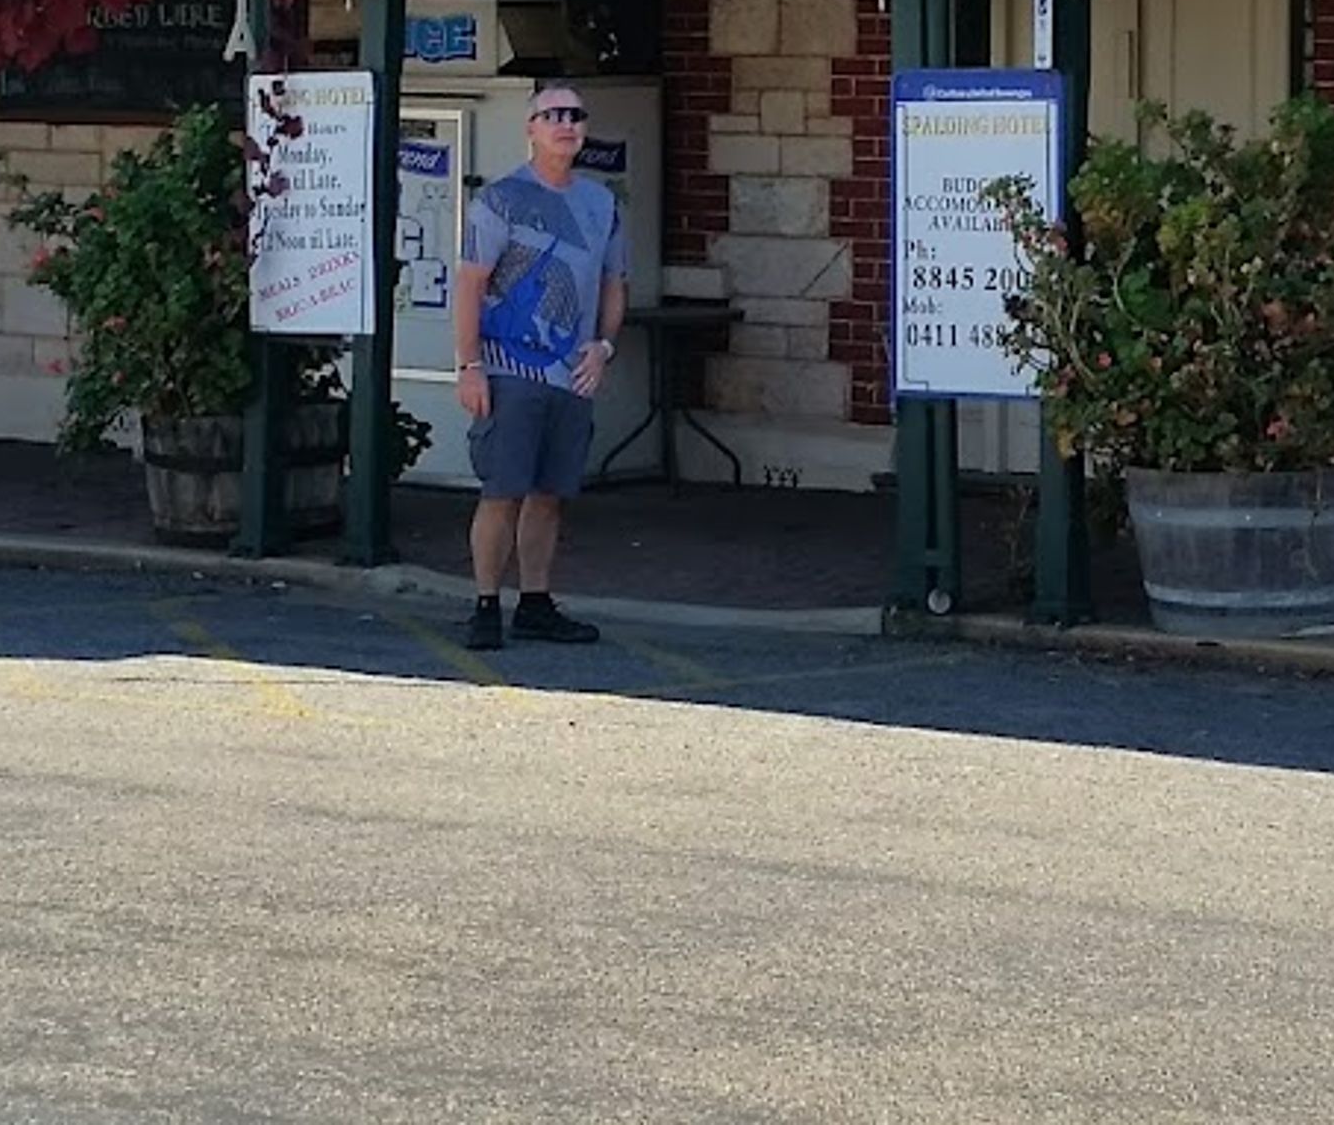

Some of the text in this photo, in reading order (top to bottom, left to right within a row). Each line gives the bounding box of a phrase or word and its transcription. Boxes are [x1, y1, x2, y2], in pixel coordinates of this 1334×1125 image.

[903, 115, 989, 137] SPALDING
[903, 240, 936, 260] Ph:
[913, 266, 1031, 292] 8845 200
[907, 324, 957, 347] 0411
